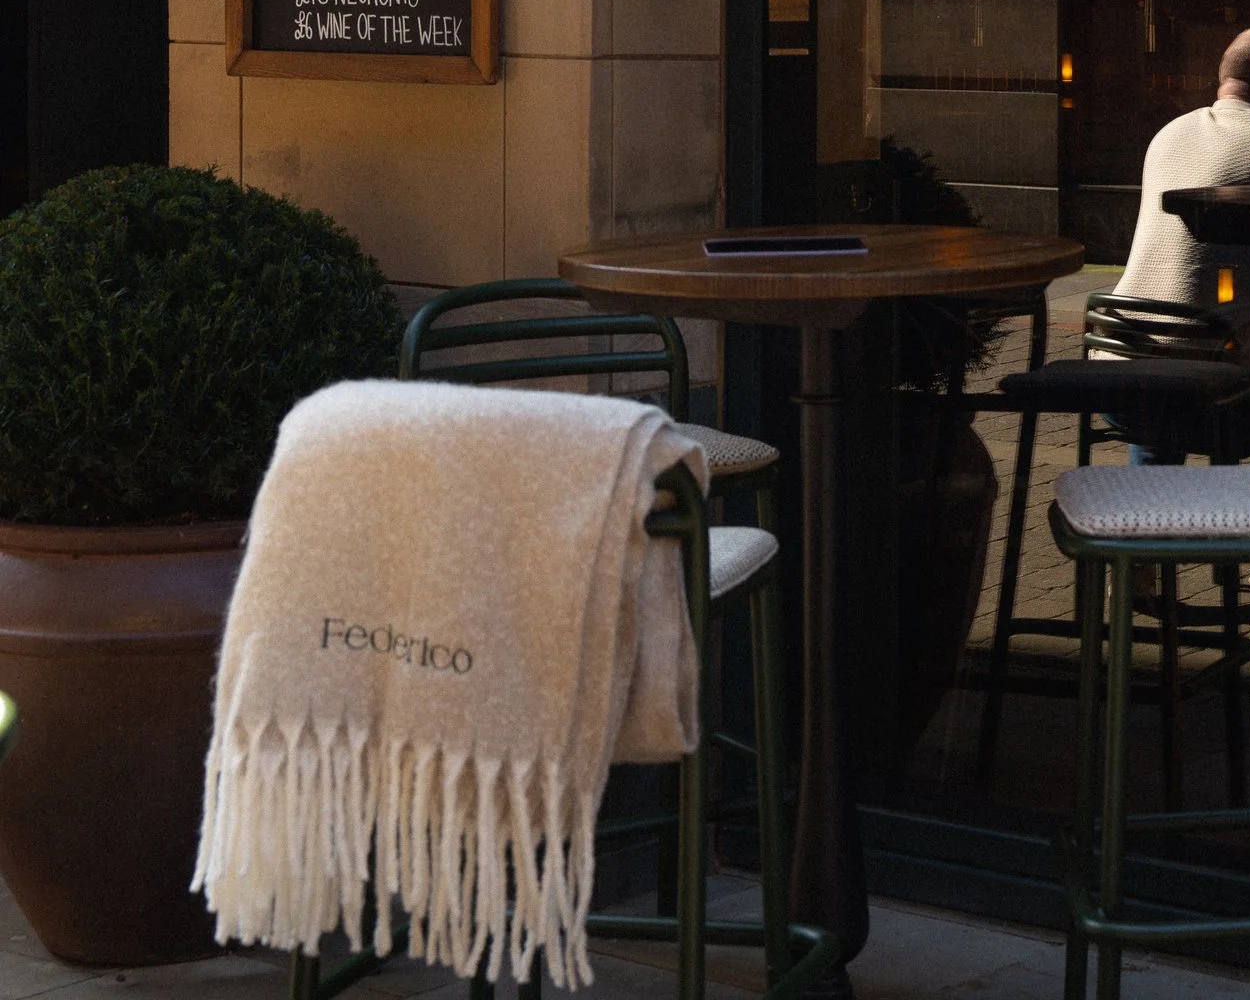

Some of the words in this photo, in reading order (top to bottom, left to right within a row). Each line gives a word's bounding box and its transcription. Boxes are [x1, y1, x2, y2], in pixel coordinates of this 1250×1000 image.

[294, 10, 314, 41] £6
[316, 11, 353, 41] WINE
[357, 12, 377, 41] OF
[379, 15, 413, 45] THE
[417, 14, 463, 47] WEEK
[321, 617, 473, 674] Federico
